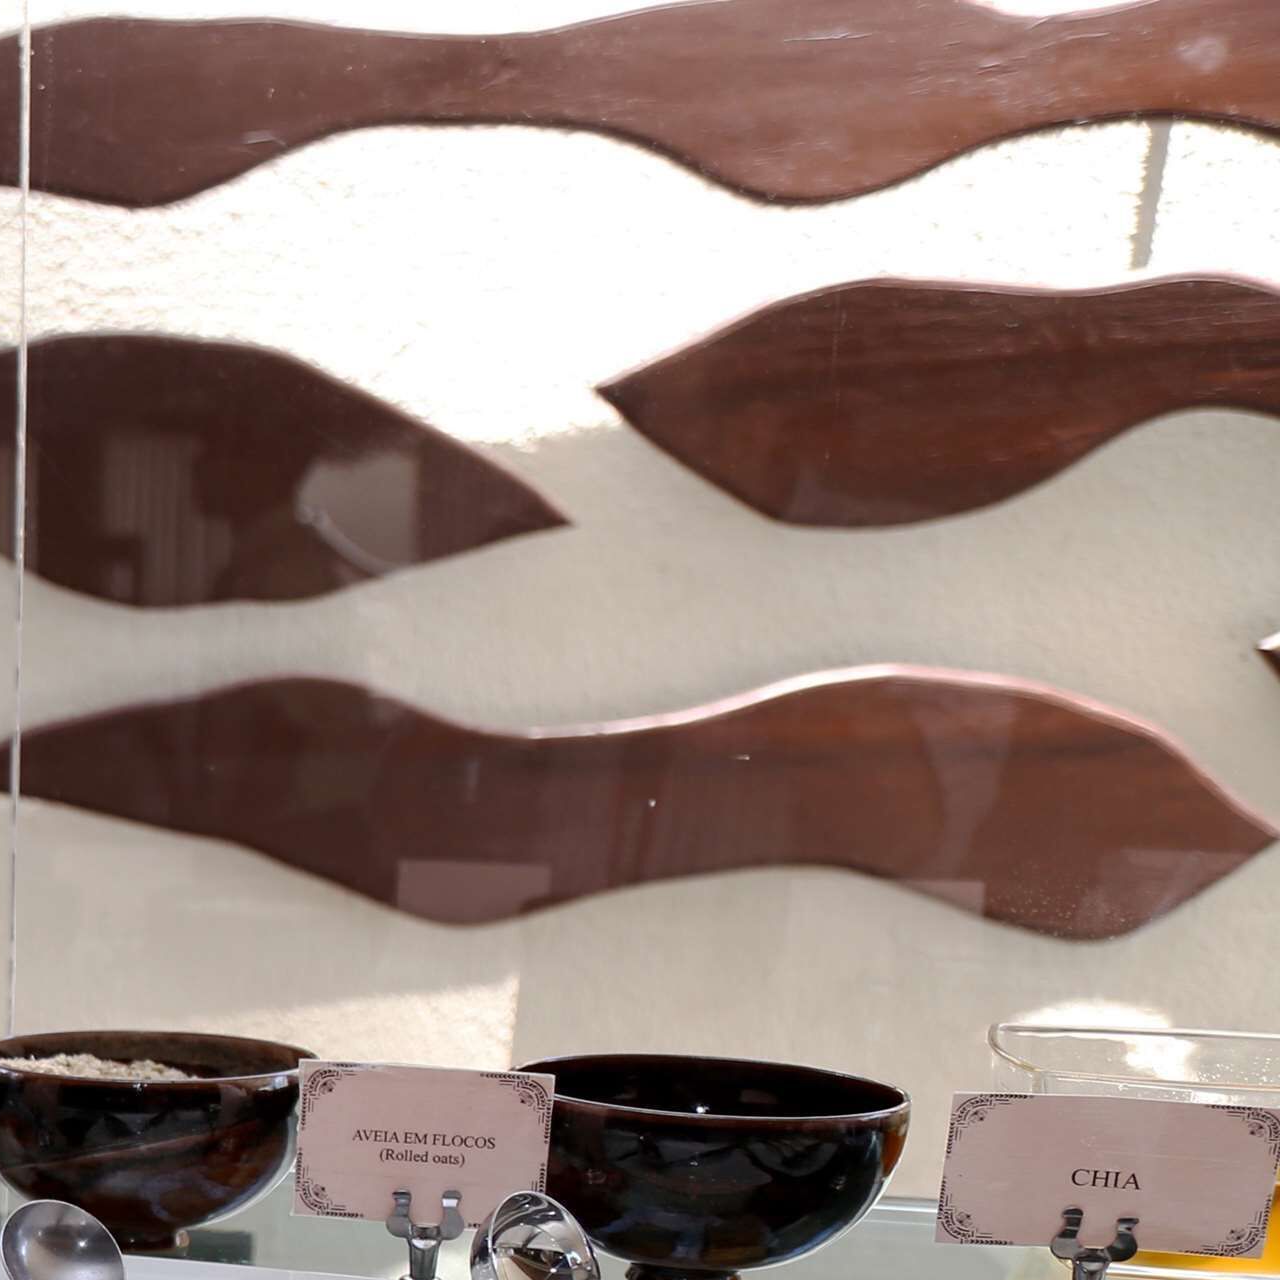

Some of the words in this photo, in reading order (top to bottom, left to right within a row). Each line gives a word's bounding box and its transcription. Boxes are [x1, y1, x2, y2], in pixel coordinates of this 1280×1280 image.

[352, 1129, 399, 1144] AVEIA
[403, 1131, 428, 1146] EM
[432, 1133, 496, 1150] FLOCOS
[379, 1148, 429, 1164] (Rolled
[432, 1151, 466, 1168] oats)
[1071, 1168, 1142, 1191] CHIA
